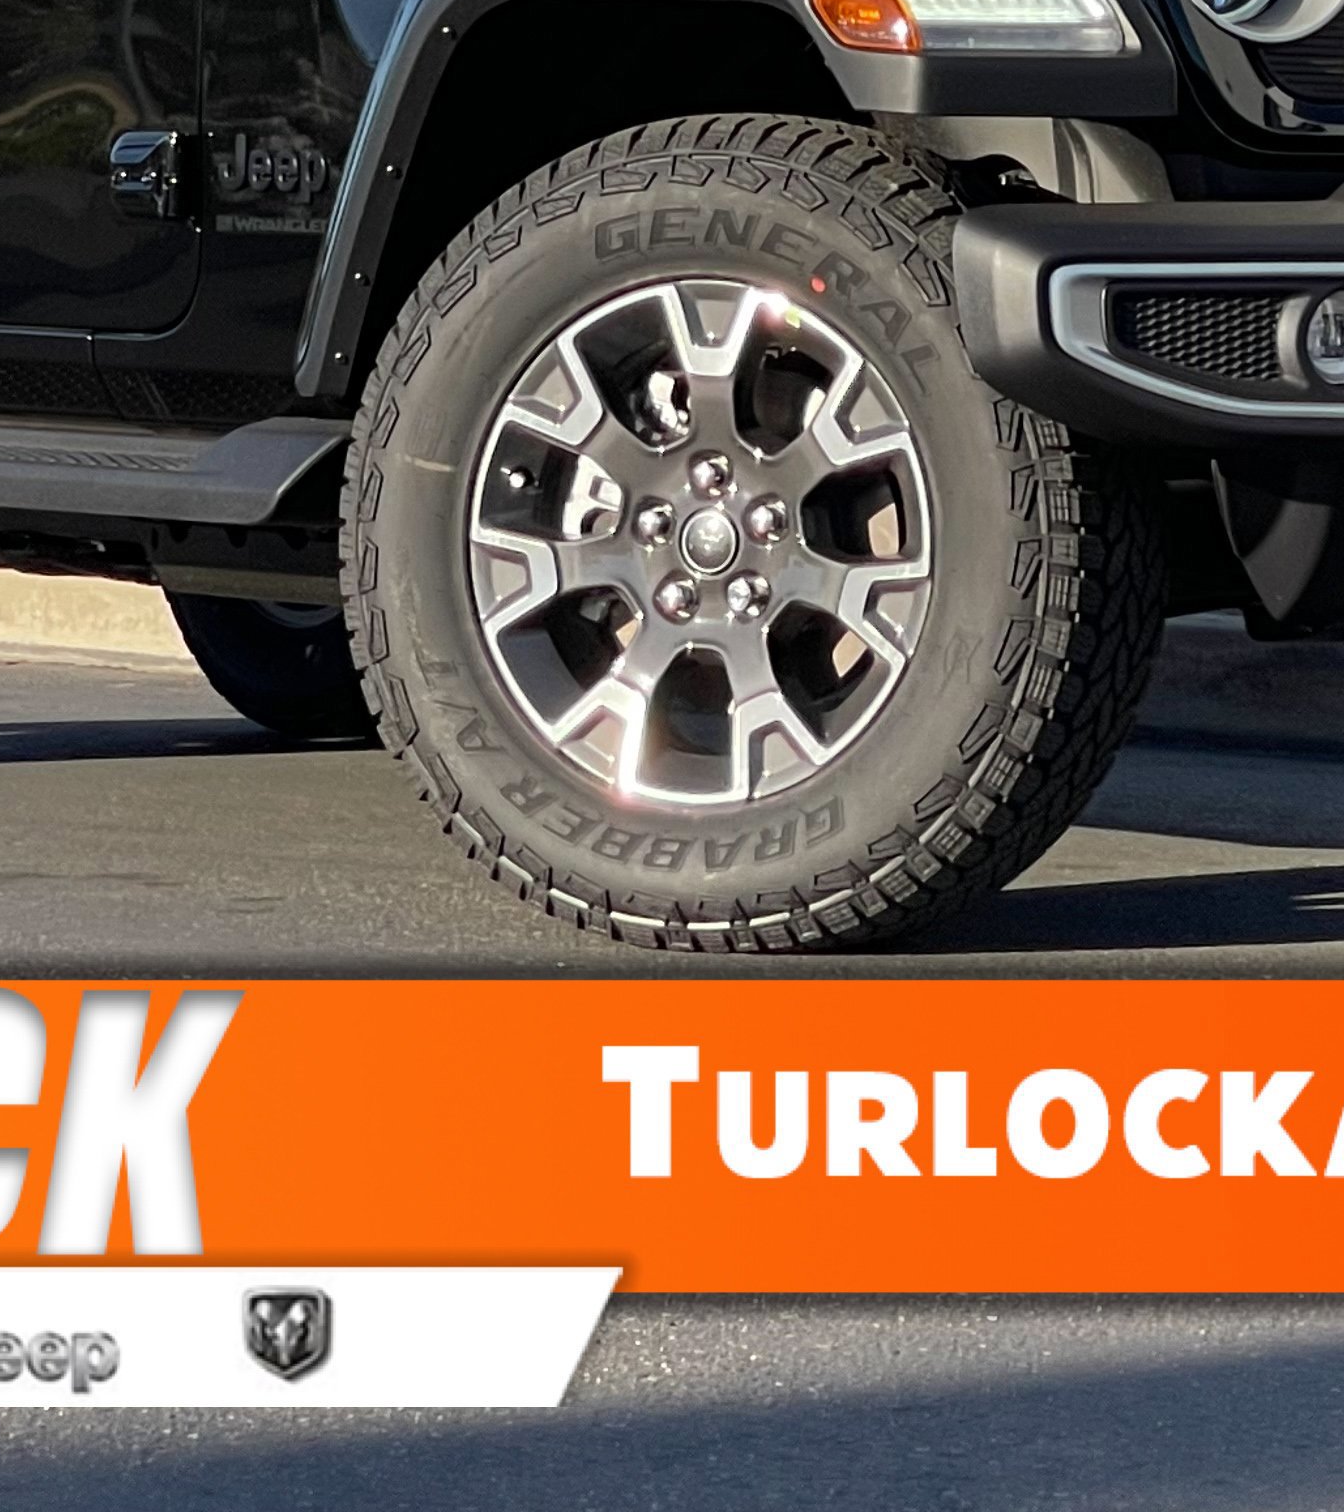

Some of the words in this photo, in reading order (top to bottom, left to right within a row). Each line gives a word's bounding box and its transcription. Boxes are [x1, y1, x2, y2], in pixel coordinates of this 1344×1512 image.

[217, 133, 327, 204] Jeep
[593, 203, 941, 396] GENERAL
[499, 775, 846, 873] GRABBER
